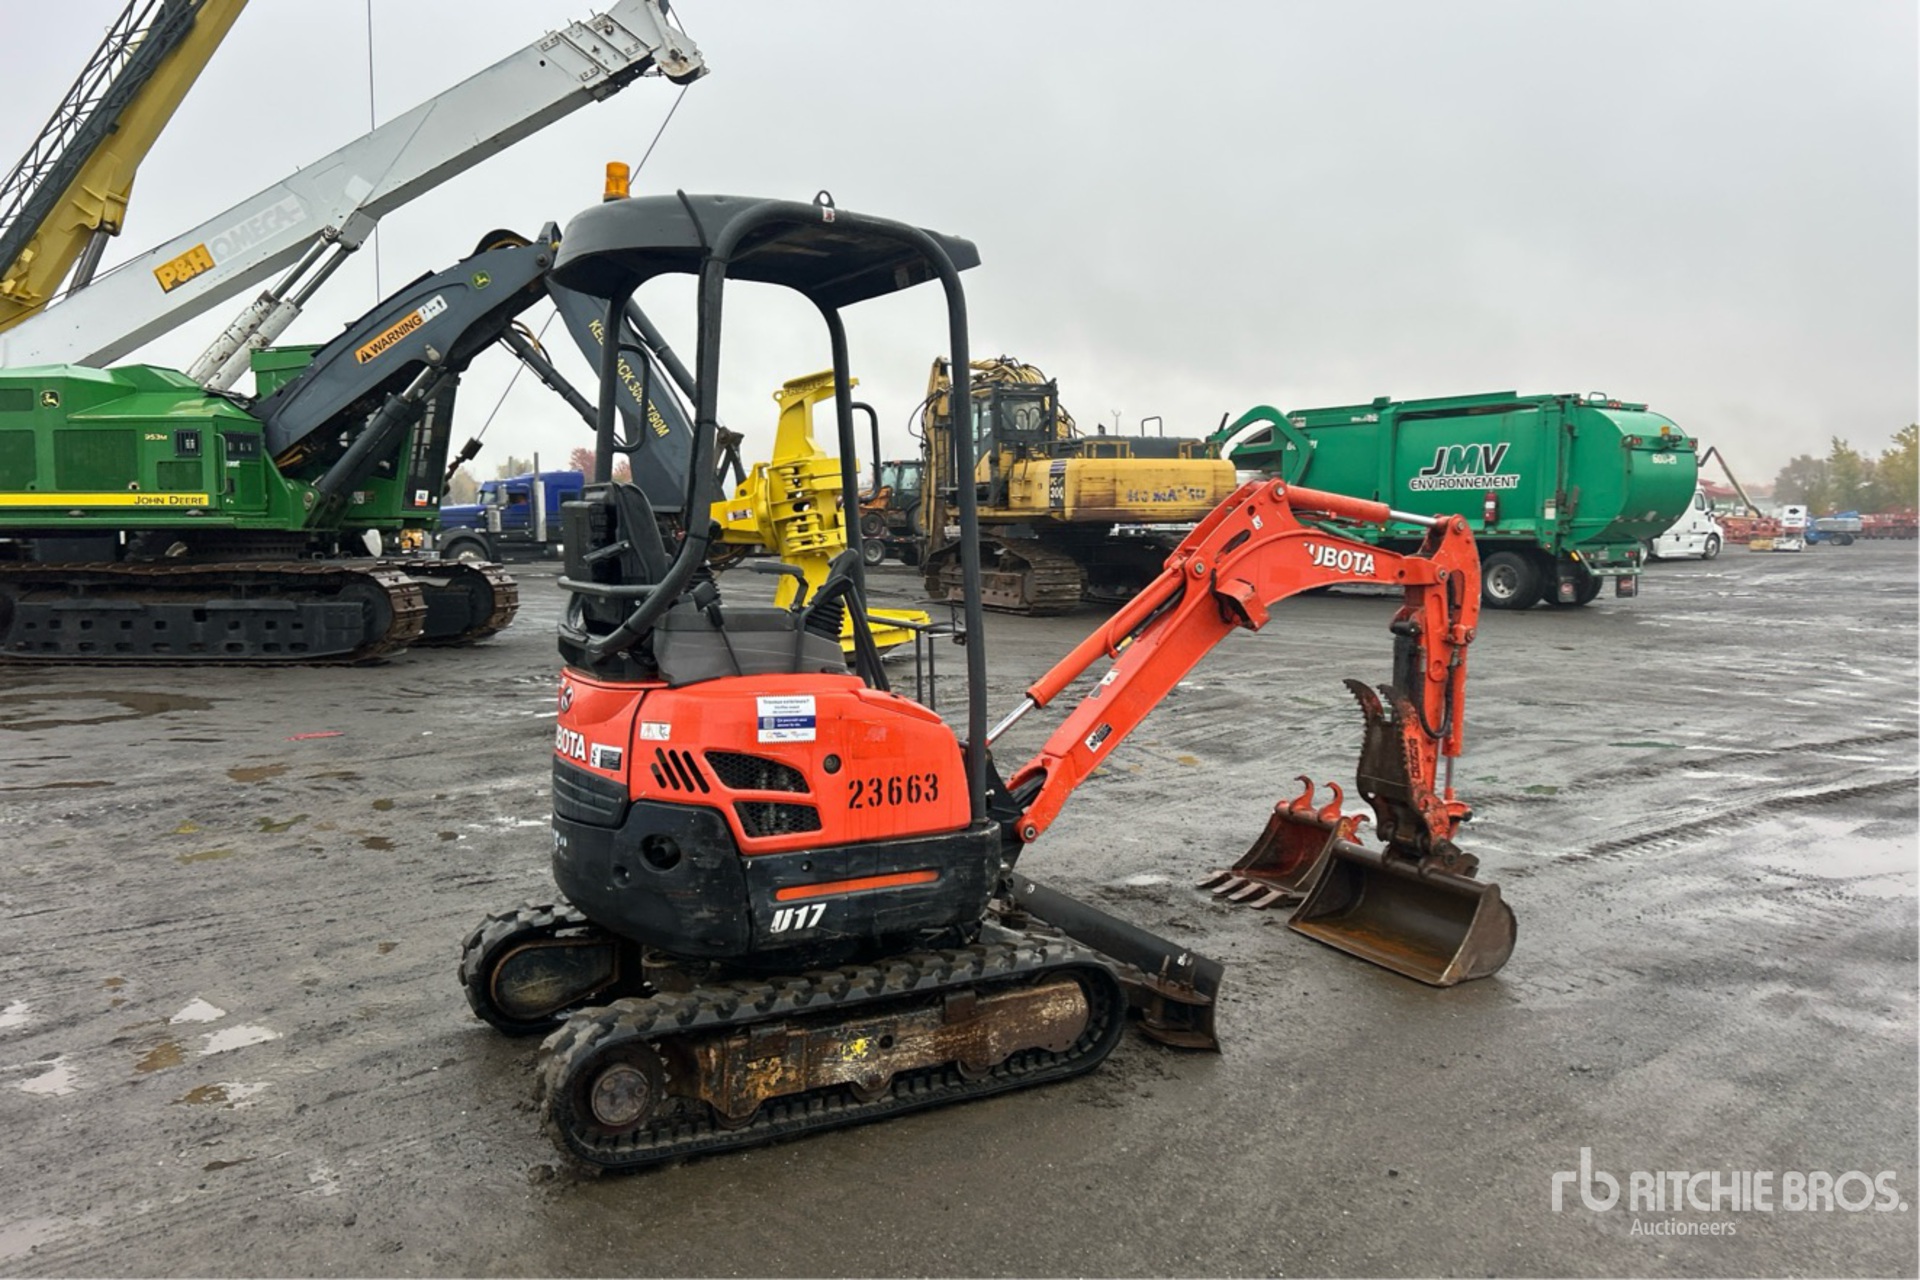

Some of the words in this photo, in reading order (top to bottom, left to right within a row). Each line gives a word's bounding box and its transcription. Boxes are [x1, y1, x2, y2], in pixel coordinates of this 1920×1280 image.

[156, 247, 215, 292] P&H
[369, 315, 423, 354] WARNING
[618, 358, 636, 384] ACK
[1420, 443, 1511, 477] JMV
[134, 495, 165, 505] JOHN
[169, 495, 204, 505] DEERE
[1410, 475, 1521, 491] ENVIRONNEMENT
[555, 723, 587, 762] BOTA
[848, 773, 938, 809] 23663
[770, 902, 827, 934] U17
